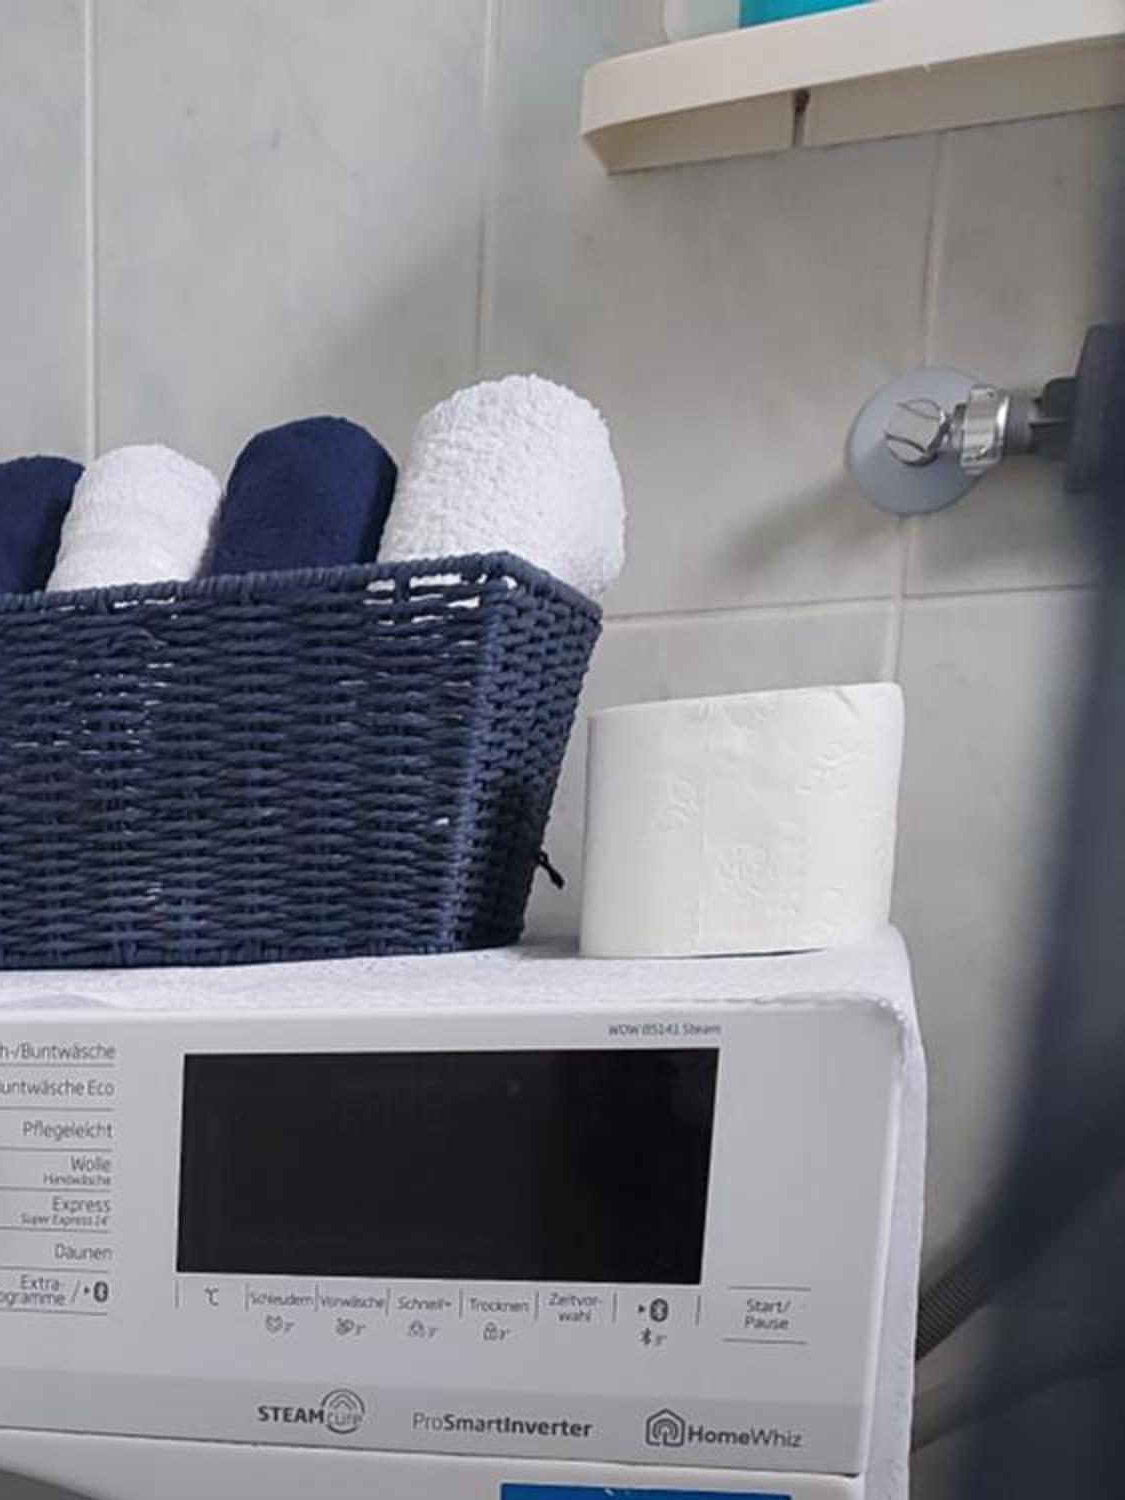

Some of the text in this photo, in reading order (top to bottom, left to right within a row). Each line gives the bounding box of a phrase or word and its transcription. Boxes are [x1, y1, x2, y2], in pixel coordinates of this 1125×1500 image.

[87, 1080, 115, 1097] Eco
[23, 1120, 114, 1142] Pflegeleicht
[70, 1155, 112, 1173] Wolle
[52, 1196, 112, 1215] Express
[55, 1243, 113, 1261] Daunen
[251, 1290, 314, 1307] Schleudern
[397, 1295, 453, 1312] Schnell+
[470, 1297, 529, 1314] Trocknen
[746, 1297, 793, 1315] Start/
[558, 1307, 592, 1323] wahl
[744, 1314, 790, 1331] Pause
[412, 1411, 593, 1438] ProSmartInverter
[688, 1424, 803, 1449] HomeWhiz
